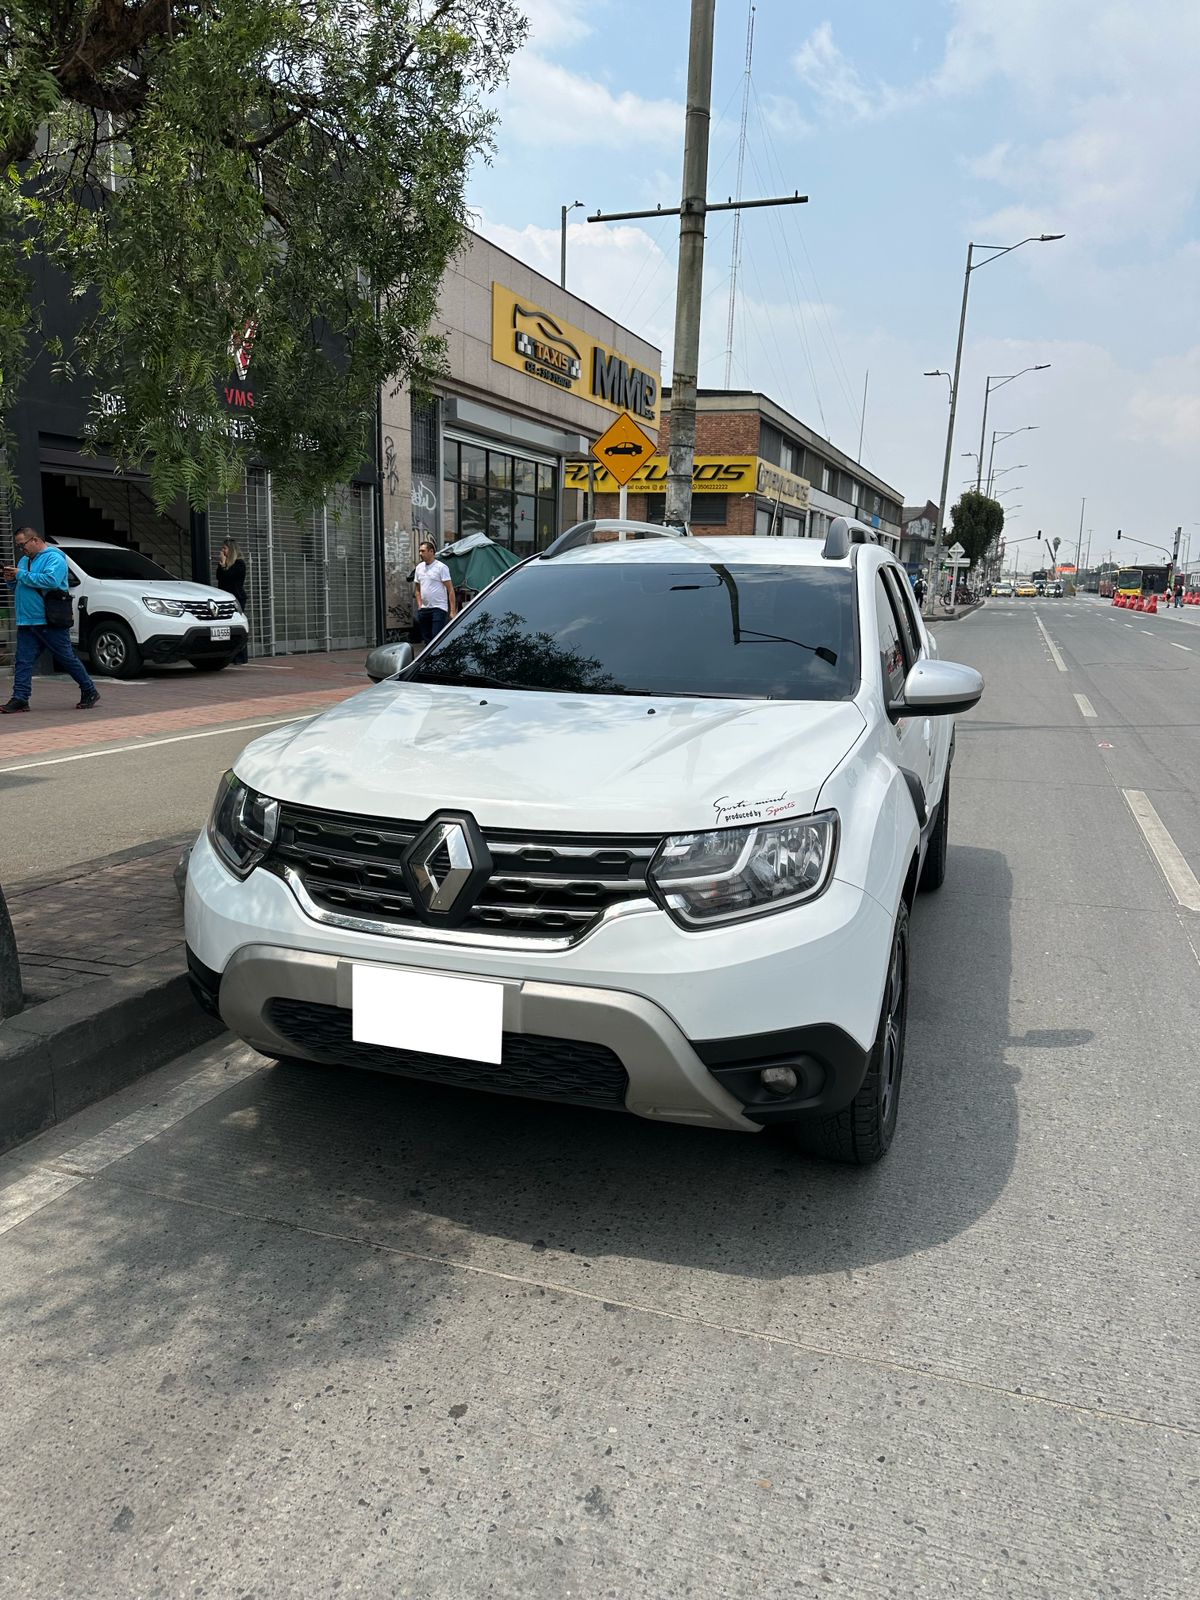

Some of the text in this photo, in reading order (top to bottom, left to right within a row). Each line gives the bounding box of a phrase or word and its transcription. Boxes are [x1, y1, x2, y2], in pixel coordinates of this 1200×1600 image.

[536, 342, 569, 370] TAXIS
[592, 346, 657, 417] MMP
[224, 387, 255, 409] VMS
[766, 801, 796, 816] Sports
